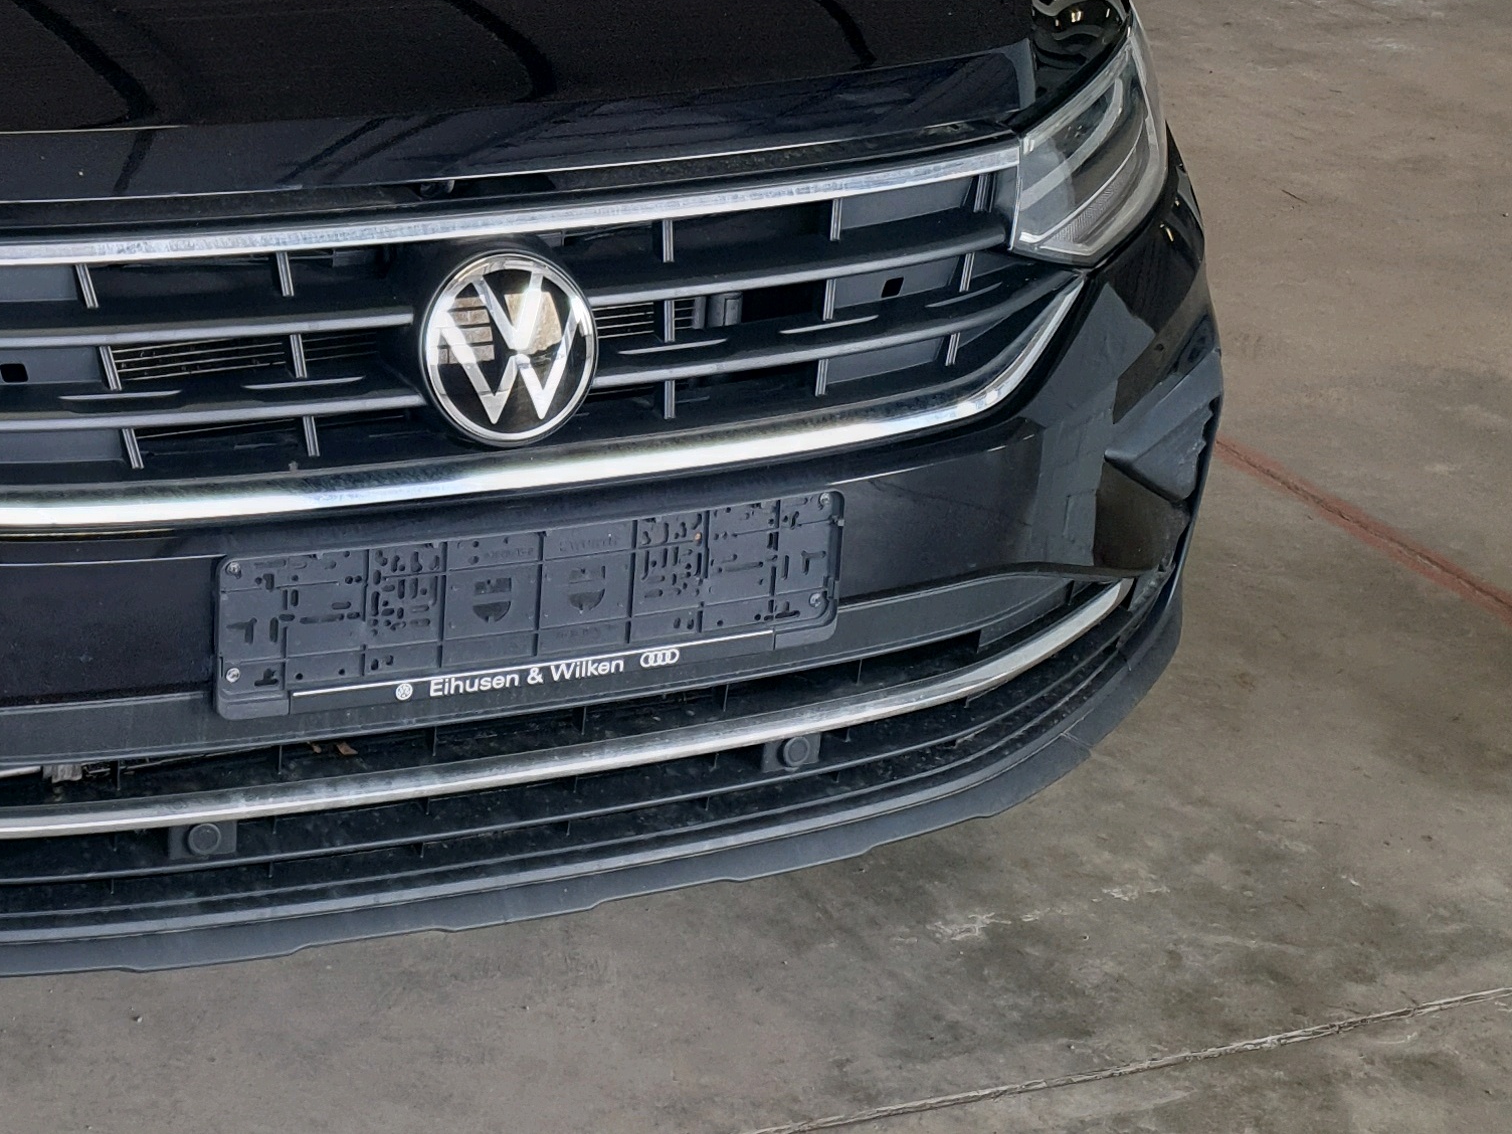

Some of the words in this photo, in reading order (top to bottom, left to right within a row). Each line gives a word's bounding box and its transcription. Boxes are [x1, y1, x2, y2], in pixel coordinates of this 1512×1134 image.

[426, 254, 594, 440] VW
[429, 673, 520, 697] Eihusen
[527, 667, 544, 685] &
[550, 659, 624, 682] Wilken
